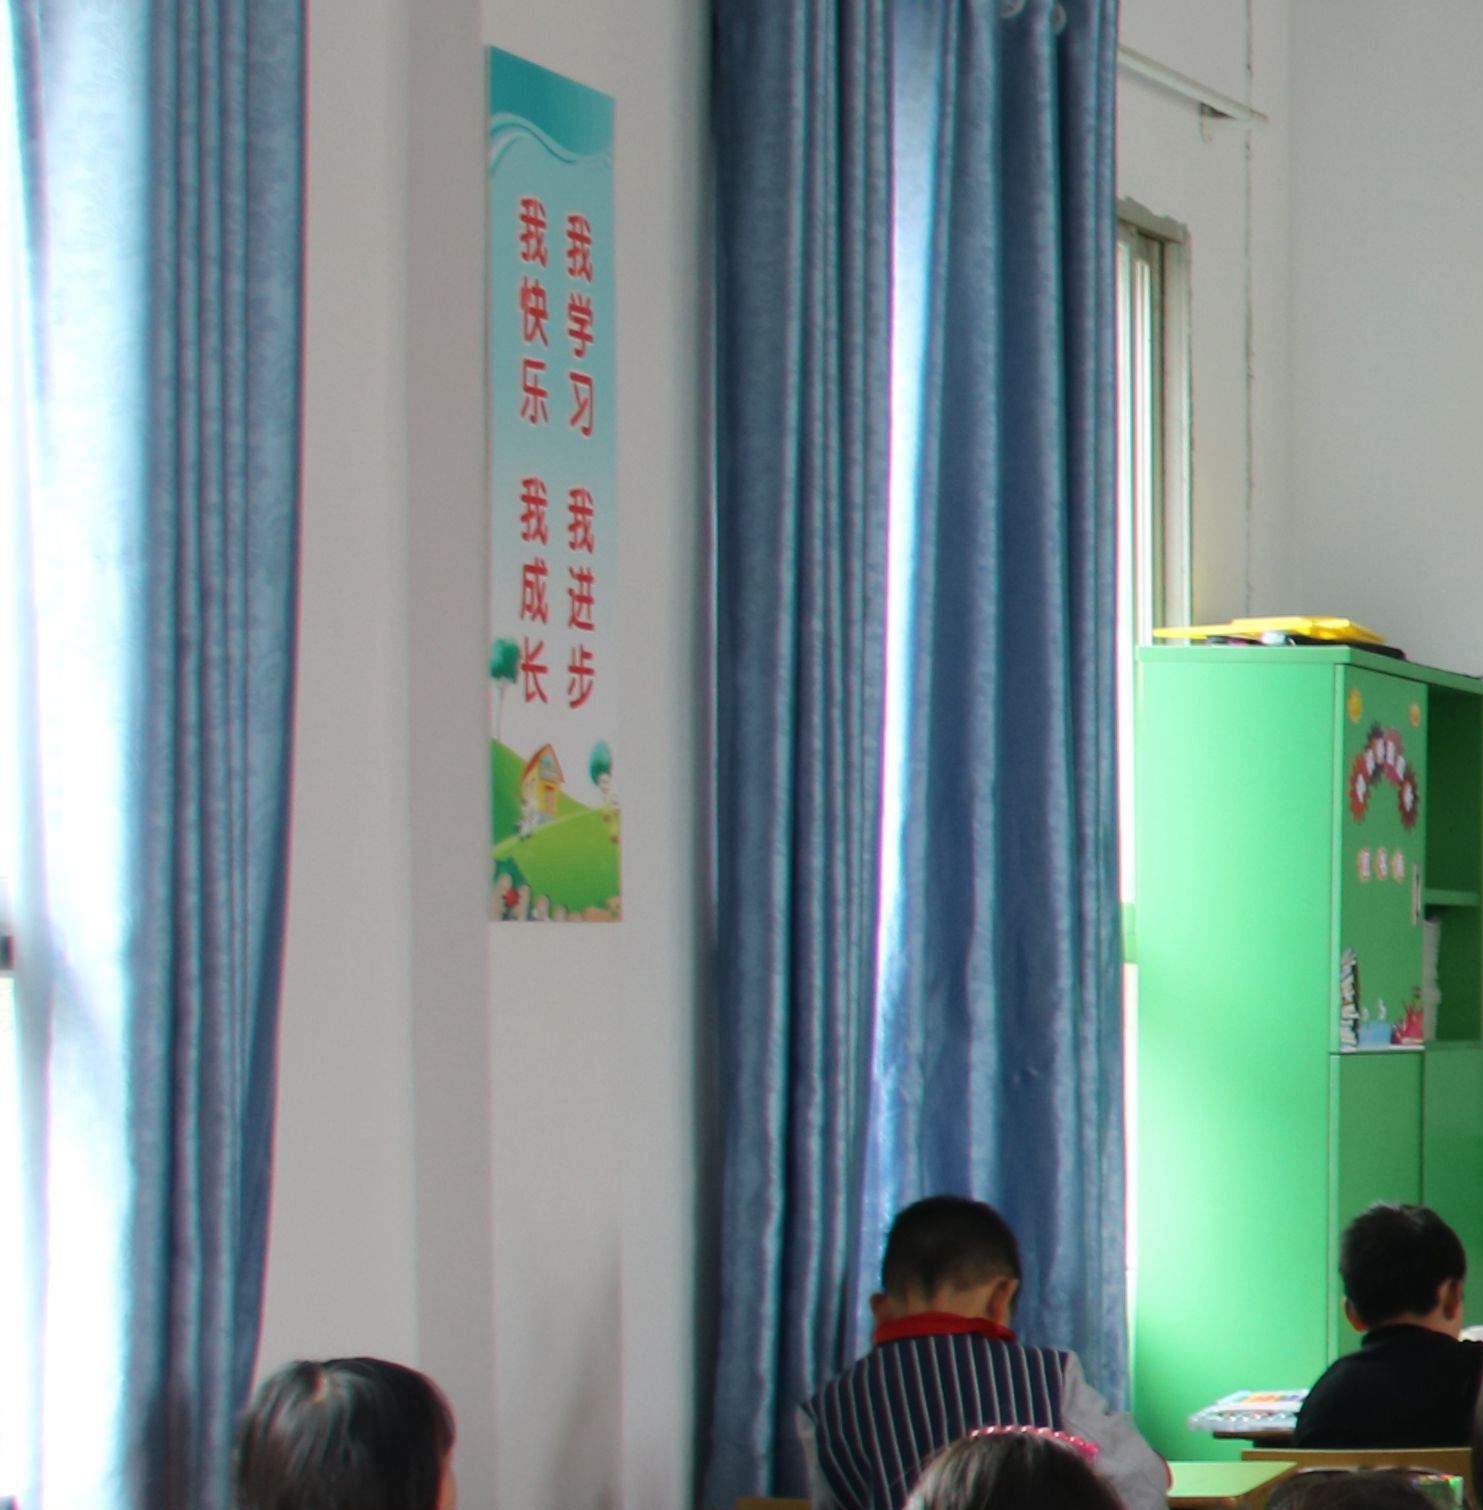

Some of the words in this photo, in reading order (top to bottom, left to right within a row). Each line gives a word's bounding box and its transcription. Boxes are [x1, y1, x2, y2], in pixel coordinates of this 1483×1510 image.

[519, 197, 549, 427] 我快乐
[566, 213, 595, 438] 我学习
[519, 476, 551, 707] 我成长
[567, 487, 598, 711] 我进步
